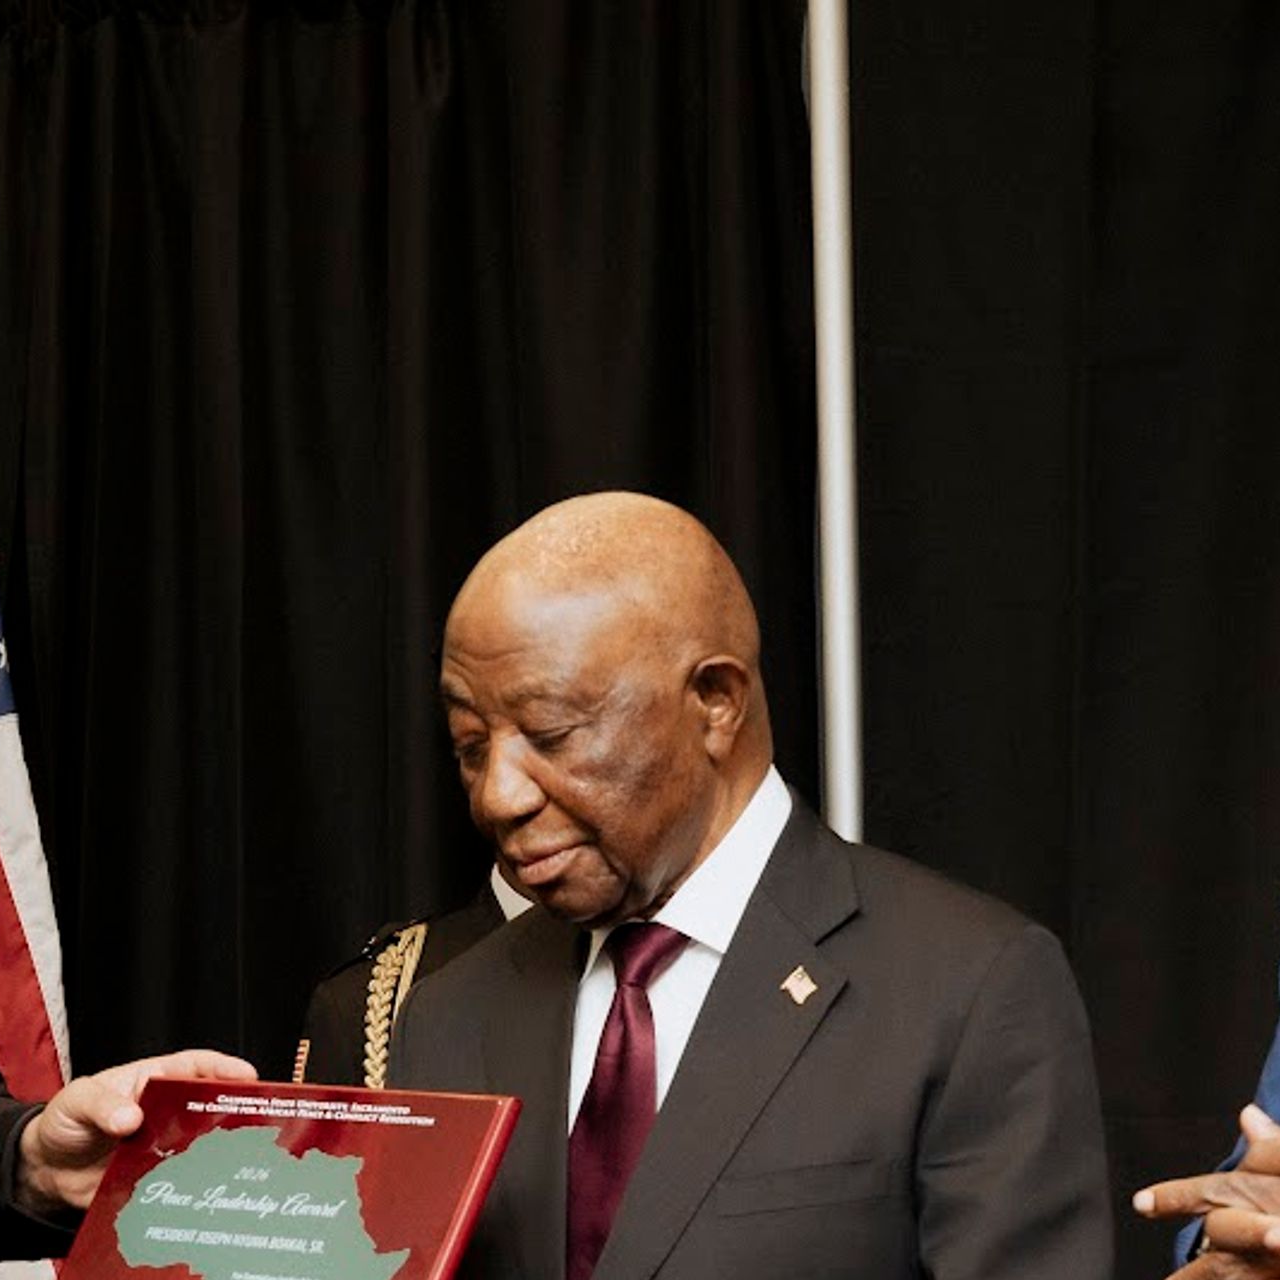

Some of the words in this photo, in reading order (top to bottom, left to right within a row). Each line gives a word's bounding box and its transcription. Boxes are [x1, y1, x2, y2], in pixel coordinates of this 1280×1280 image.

[140, 1181, 193, 1207] Peace
[193, 1185, 279, 1219] Leadership
[279, 1192, 347, 1218] Award
